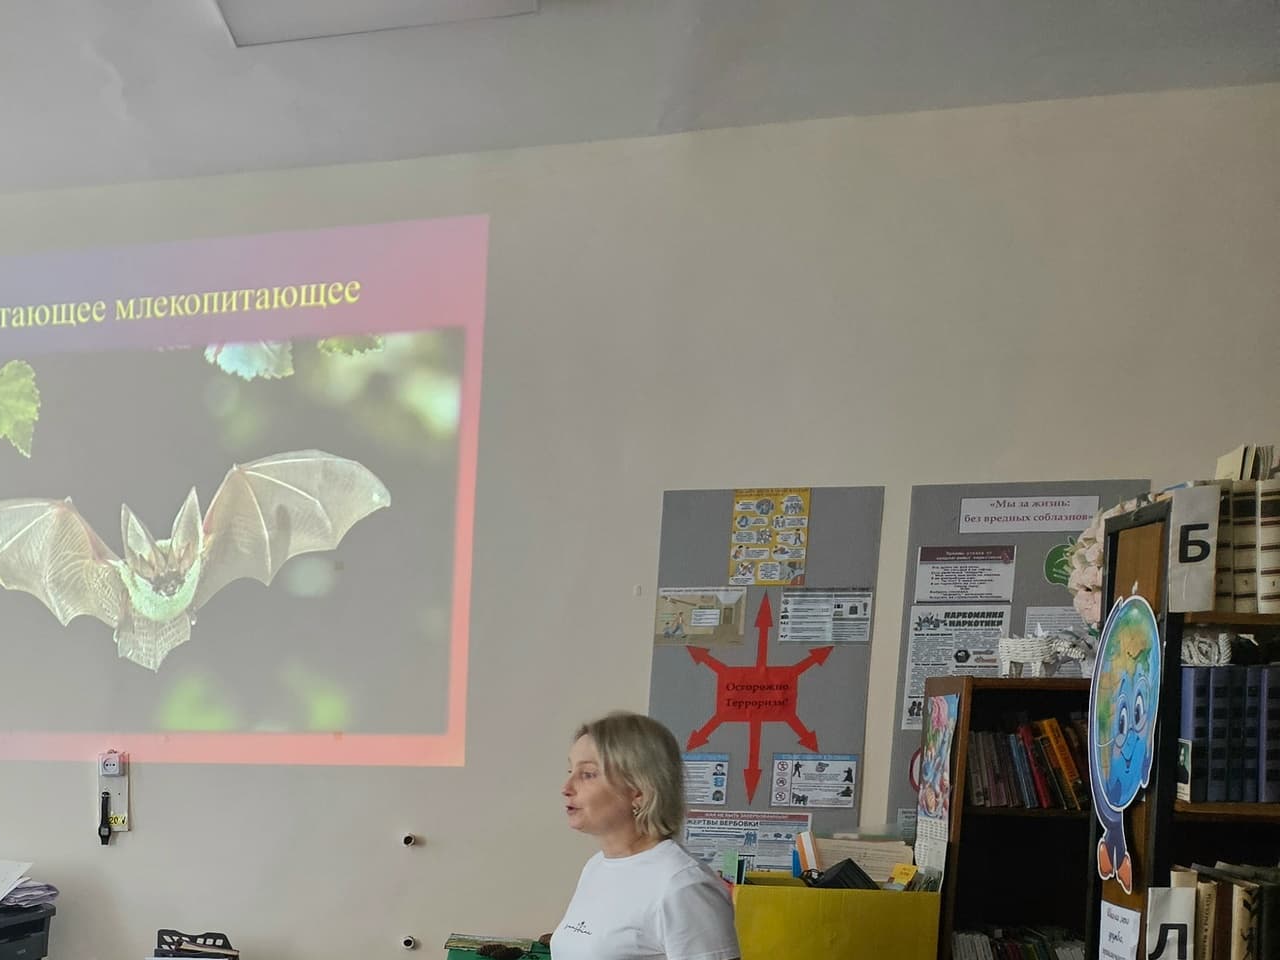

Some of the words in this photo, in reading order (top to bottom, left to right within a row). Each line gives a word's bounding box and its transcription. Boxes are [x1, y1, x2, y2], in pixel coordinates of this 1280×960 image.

[114, 279, 361, 322] млекопитающее
[989, 499, 1016, 508] «Мы
[964, 513, 981, 523] без
[983, 514, 1031, 525] вредных
[1177, 524, 1211, 564] Б
[944, 611, 1004, 619] НАРКОМАНИЯ
[948, 619, 1003, 628] НАРКОТИКИ
[726, 683, 789, 694] Осторожно
[726, 698, 789, 710] Терроризм!
[1148, 923, 1187, 960] Л
